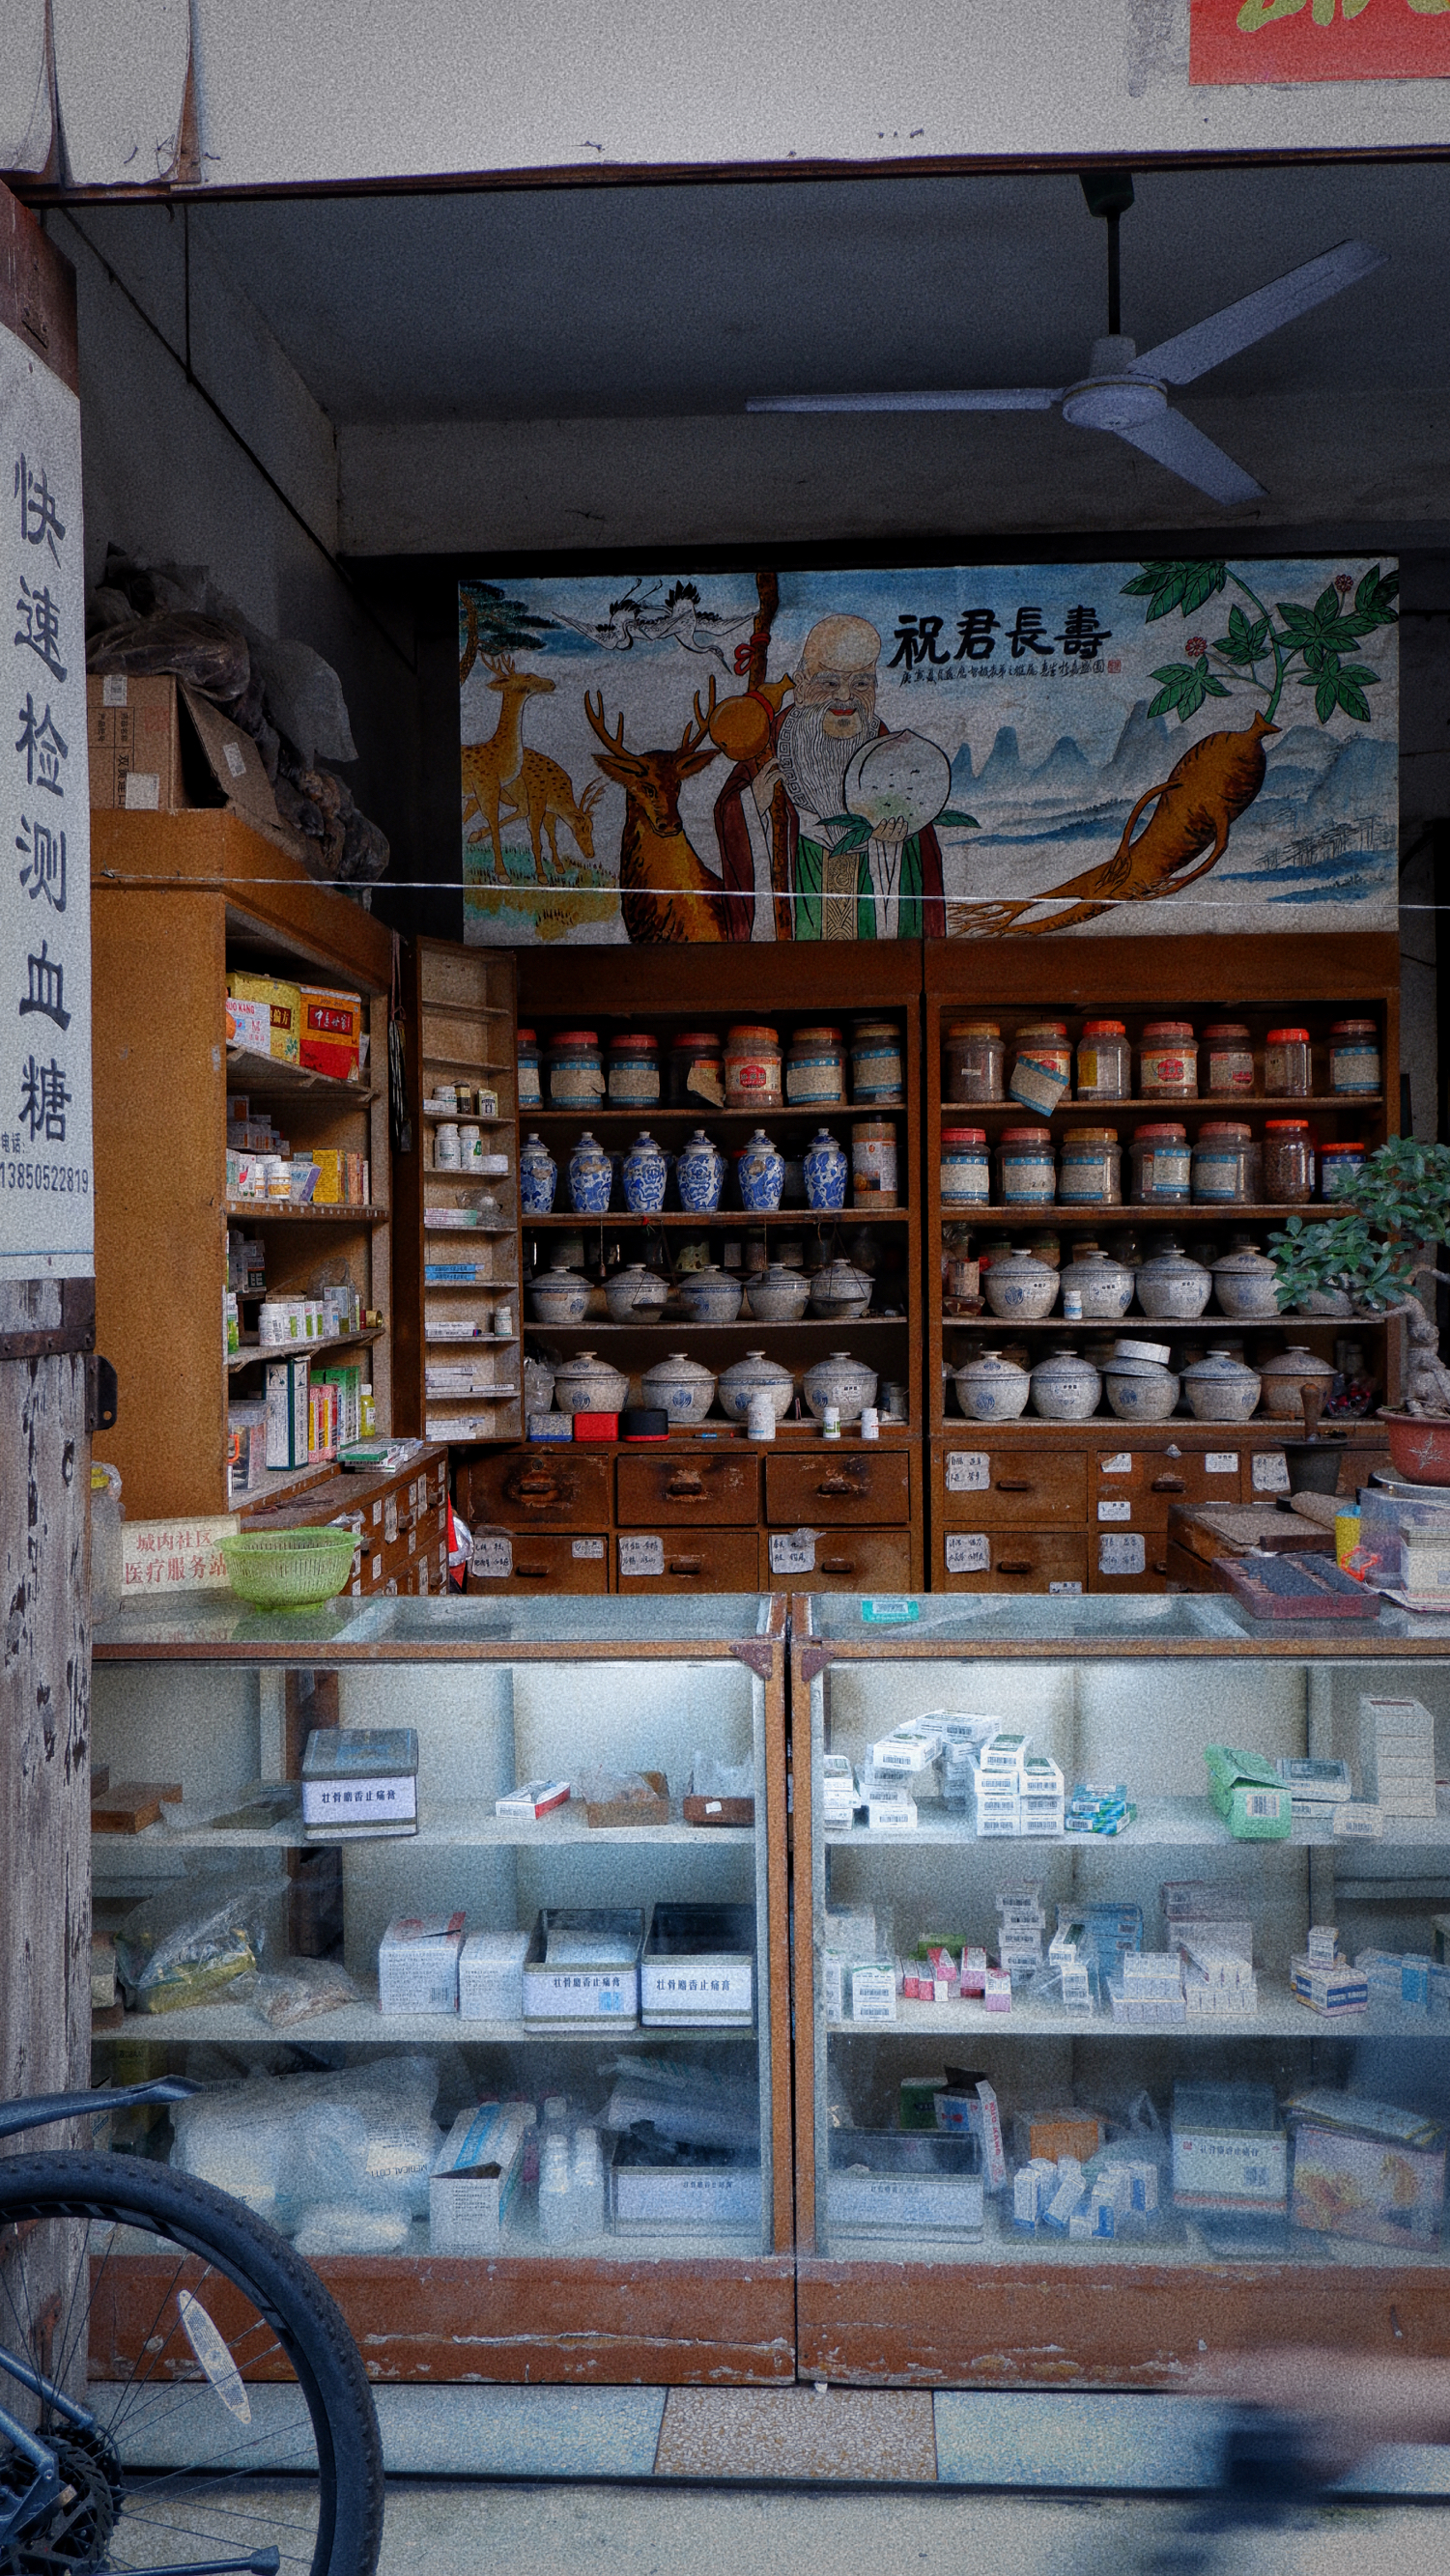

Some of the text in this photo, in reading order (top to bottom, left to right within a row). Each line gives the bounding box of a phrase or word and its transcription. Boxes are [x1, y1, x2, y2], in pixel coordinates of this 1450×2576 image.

[886, 604, 1113, 670] 祝君長壽
[14, 452, 72, 1144] 快速检测血糖
[136, 1530, 213, 1553] 城内社区
[126, 1552, 226, 1586] 医疗服务站
[322, 1789, 396, 1804] 壮骨麝香止痛膏
[554, 1976, 621, 1989] 壮骨麝香止痛膏
[656, 1978, 731, 1992] 壮骨麝香止痛膏
[394, 2164, 428, 2175] MEDICAL
